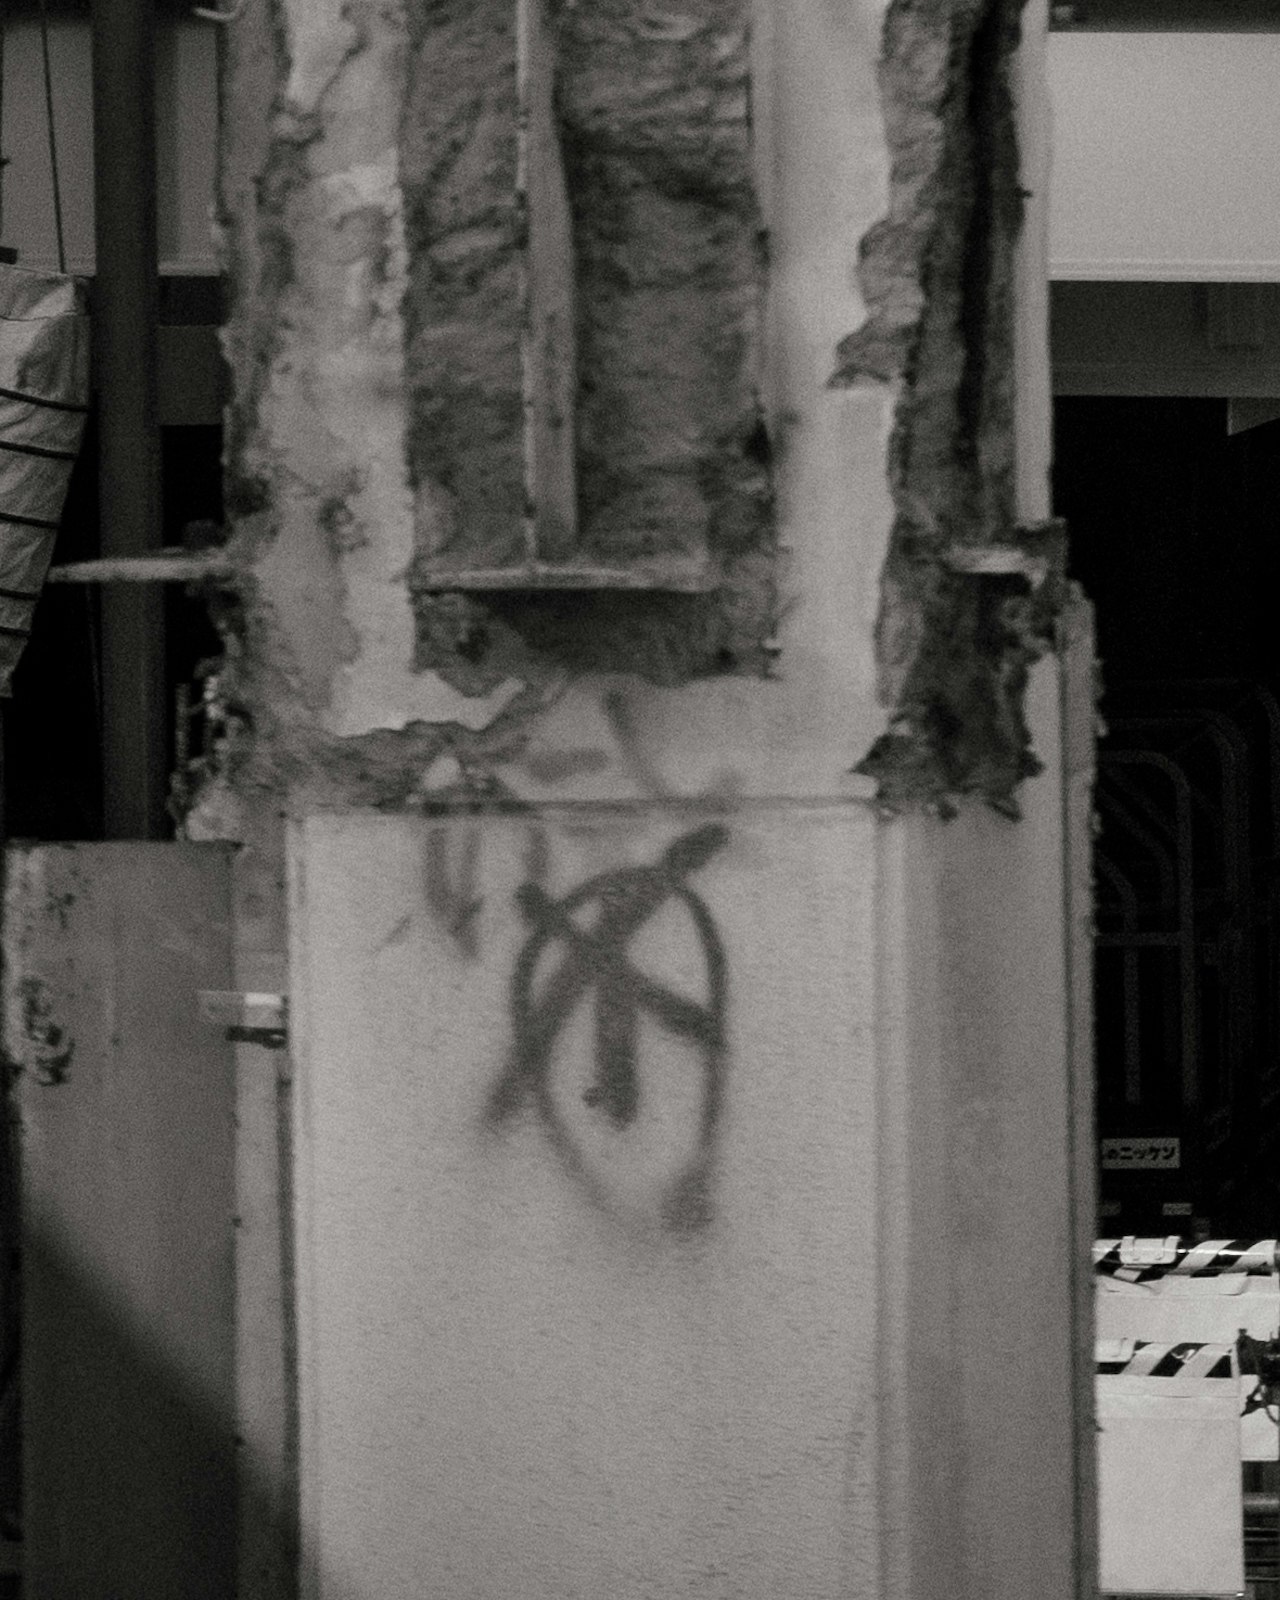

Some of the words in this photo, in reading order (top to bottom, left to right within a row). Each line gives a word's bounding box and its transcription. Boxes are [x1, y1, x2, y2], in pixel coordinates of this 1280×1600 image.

[1102, 1146, 1177, 1161] のニッケン
